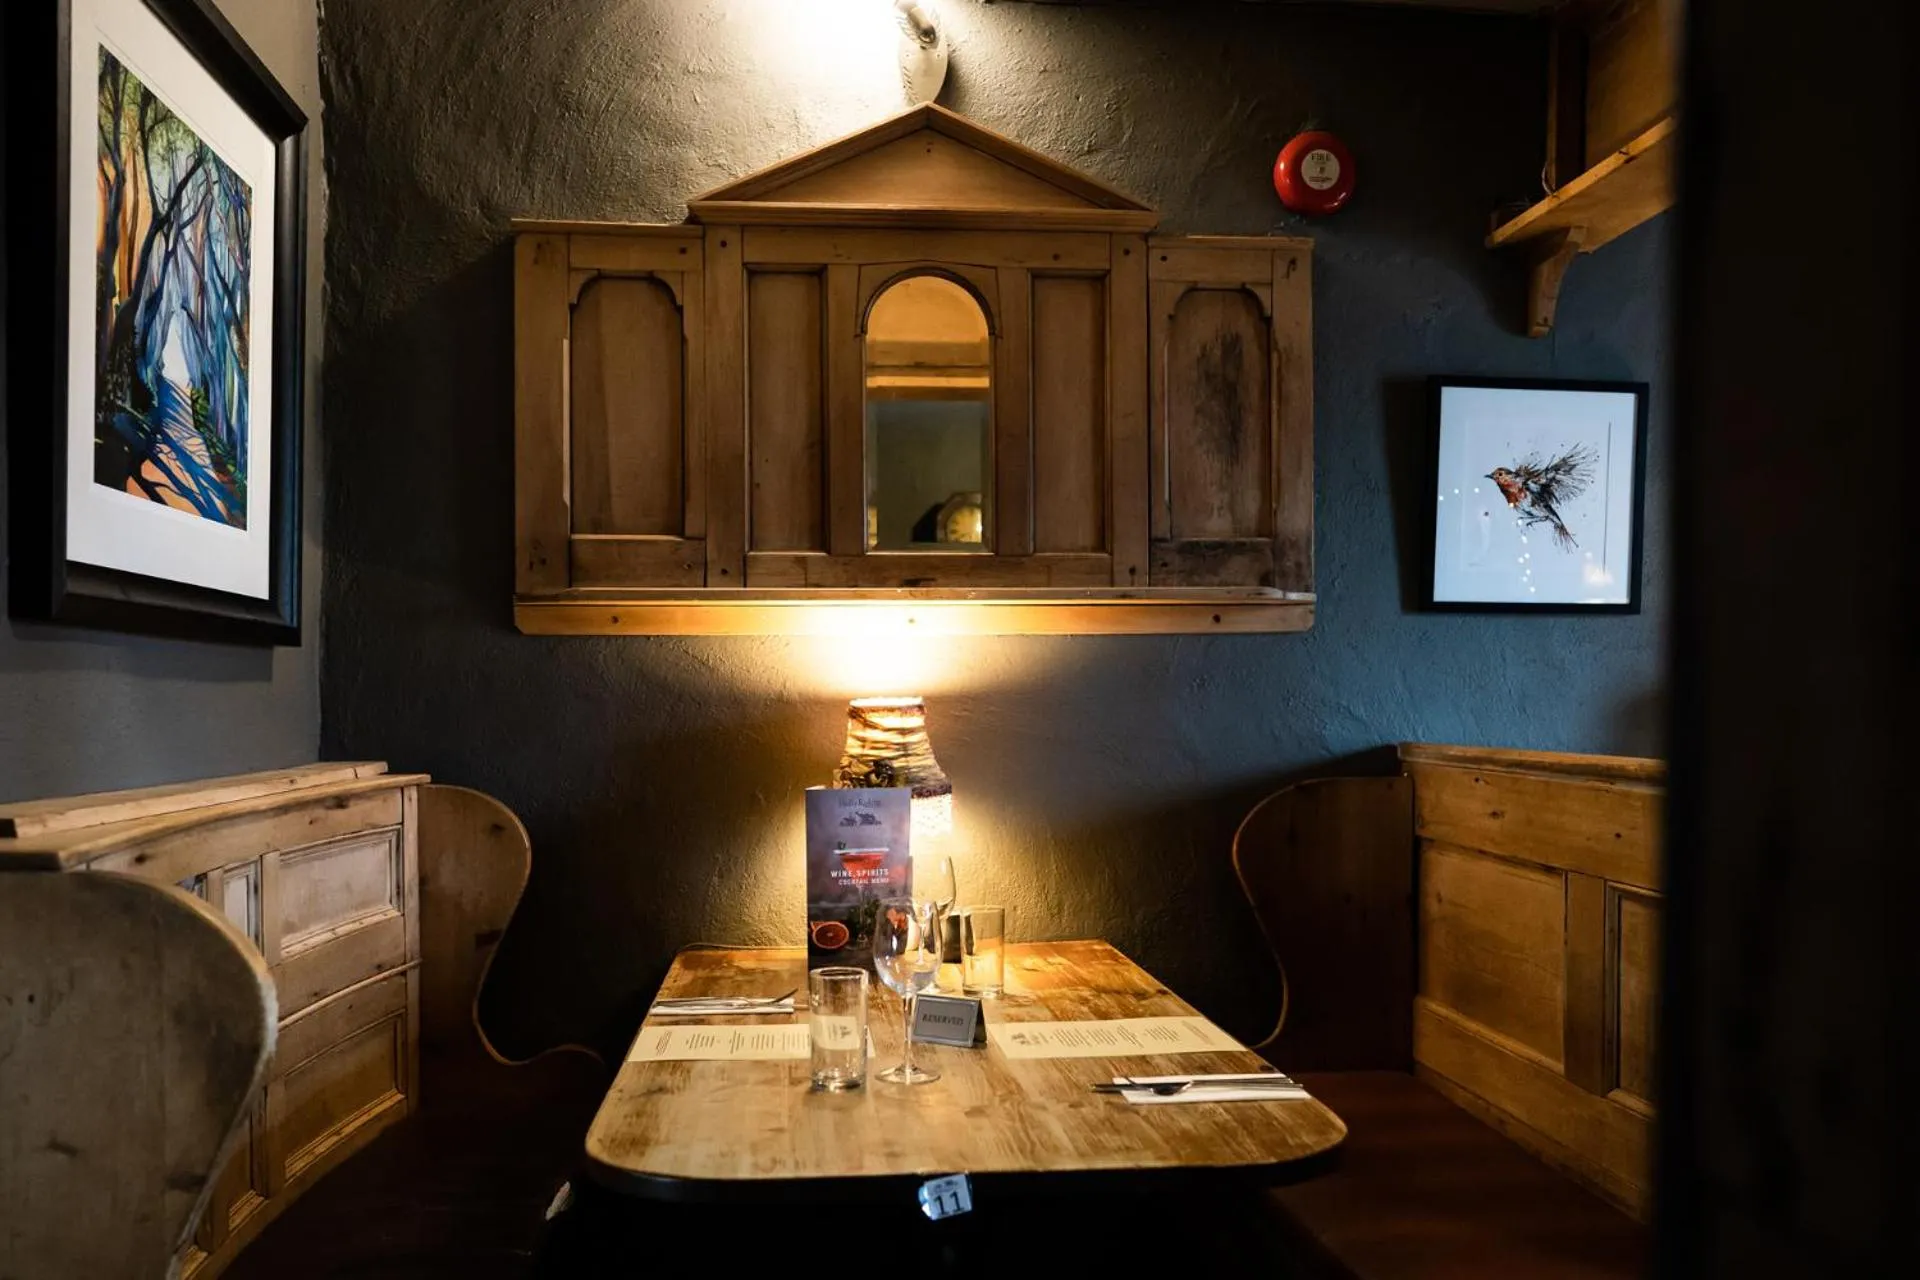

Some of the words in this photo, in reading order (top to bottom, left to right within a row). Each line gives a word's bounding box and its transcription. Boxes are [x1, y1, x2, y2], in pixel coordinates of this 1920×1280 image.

[856, 868, 889, 877] SPIRITS
[922, 1013, 964, 1026] RESERVED
[933, 1190, 965, 1216] 11
